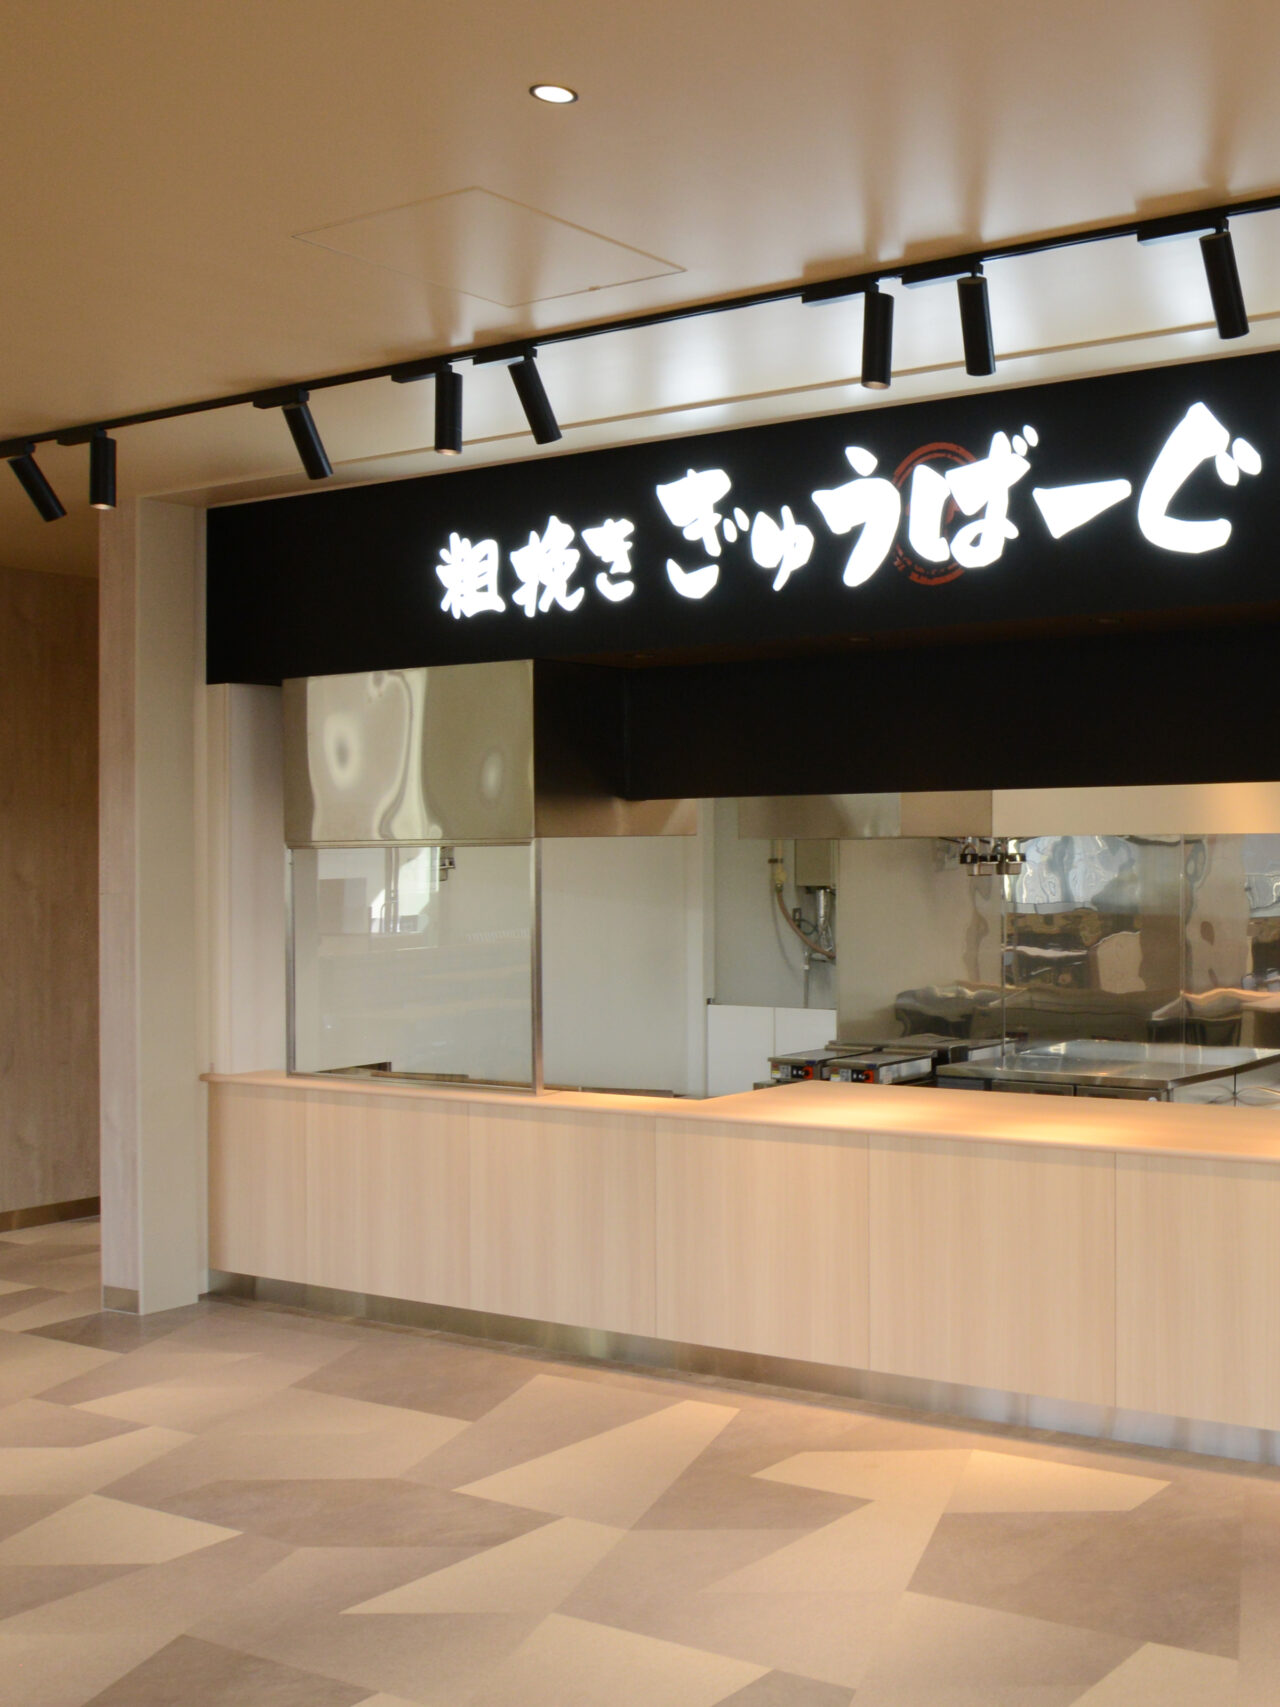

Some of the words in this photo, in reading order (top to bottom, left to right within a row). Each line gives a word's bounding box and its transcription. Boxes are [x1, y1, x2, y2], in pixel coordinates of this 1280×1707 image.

[435, 515, 635, 620] 粗挽き
[656, 401, 1263, 600] ぎゅうばーぐ
